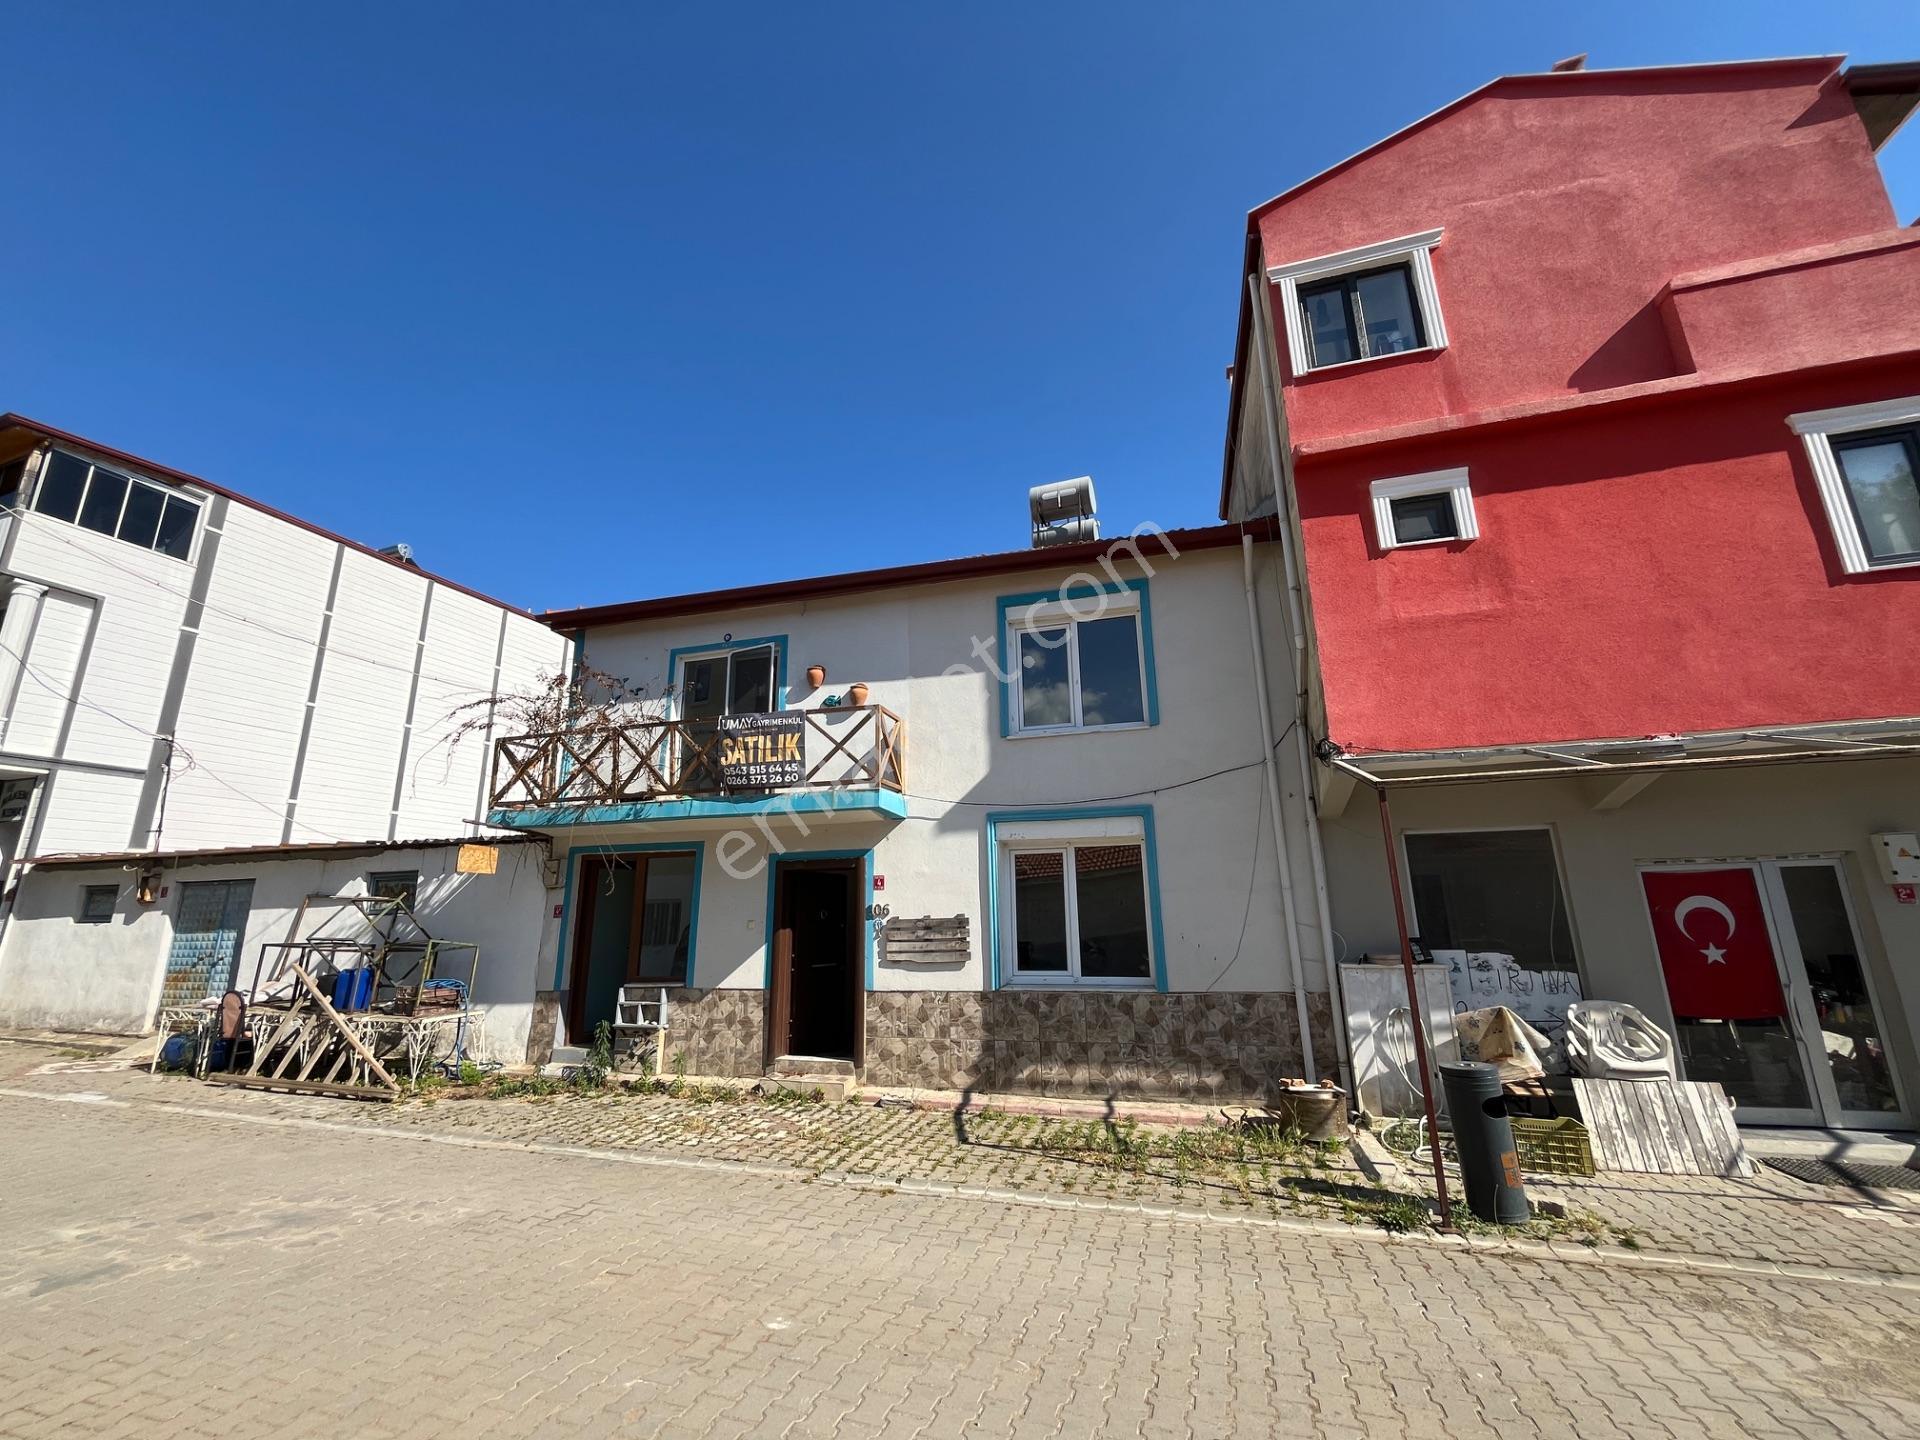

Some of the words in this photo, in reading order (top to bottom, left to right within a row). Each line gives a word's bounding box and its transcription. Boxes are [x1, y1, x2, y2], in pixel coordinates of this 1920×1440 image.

[720, 732, 801, 766] SATILIK
[723, 766, 747, 776] 0543
[749, 765, 767, 774] 515
[768, 764, 782, 773] 64
[784, 763, 798, 772] 45
[726, 776, 748, 785] 0266
[749, 775, 767, 784] 373
[769, 774, 782, 783] 26
[784, 773, 799, 782] 60
